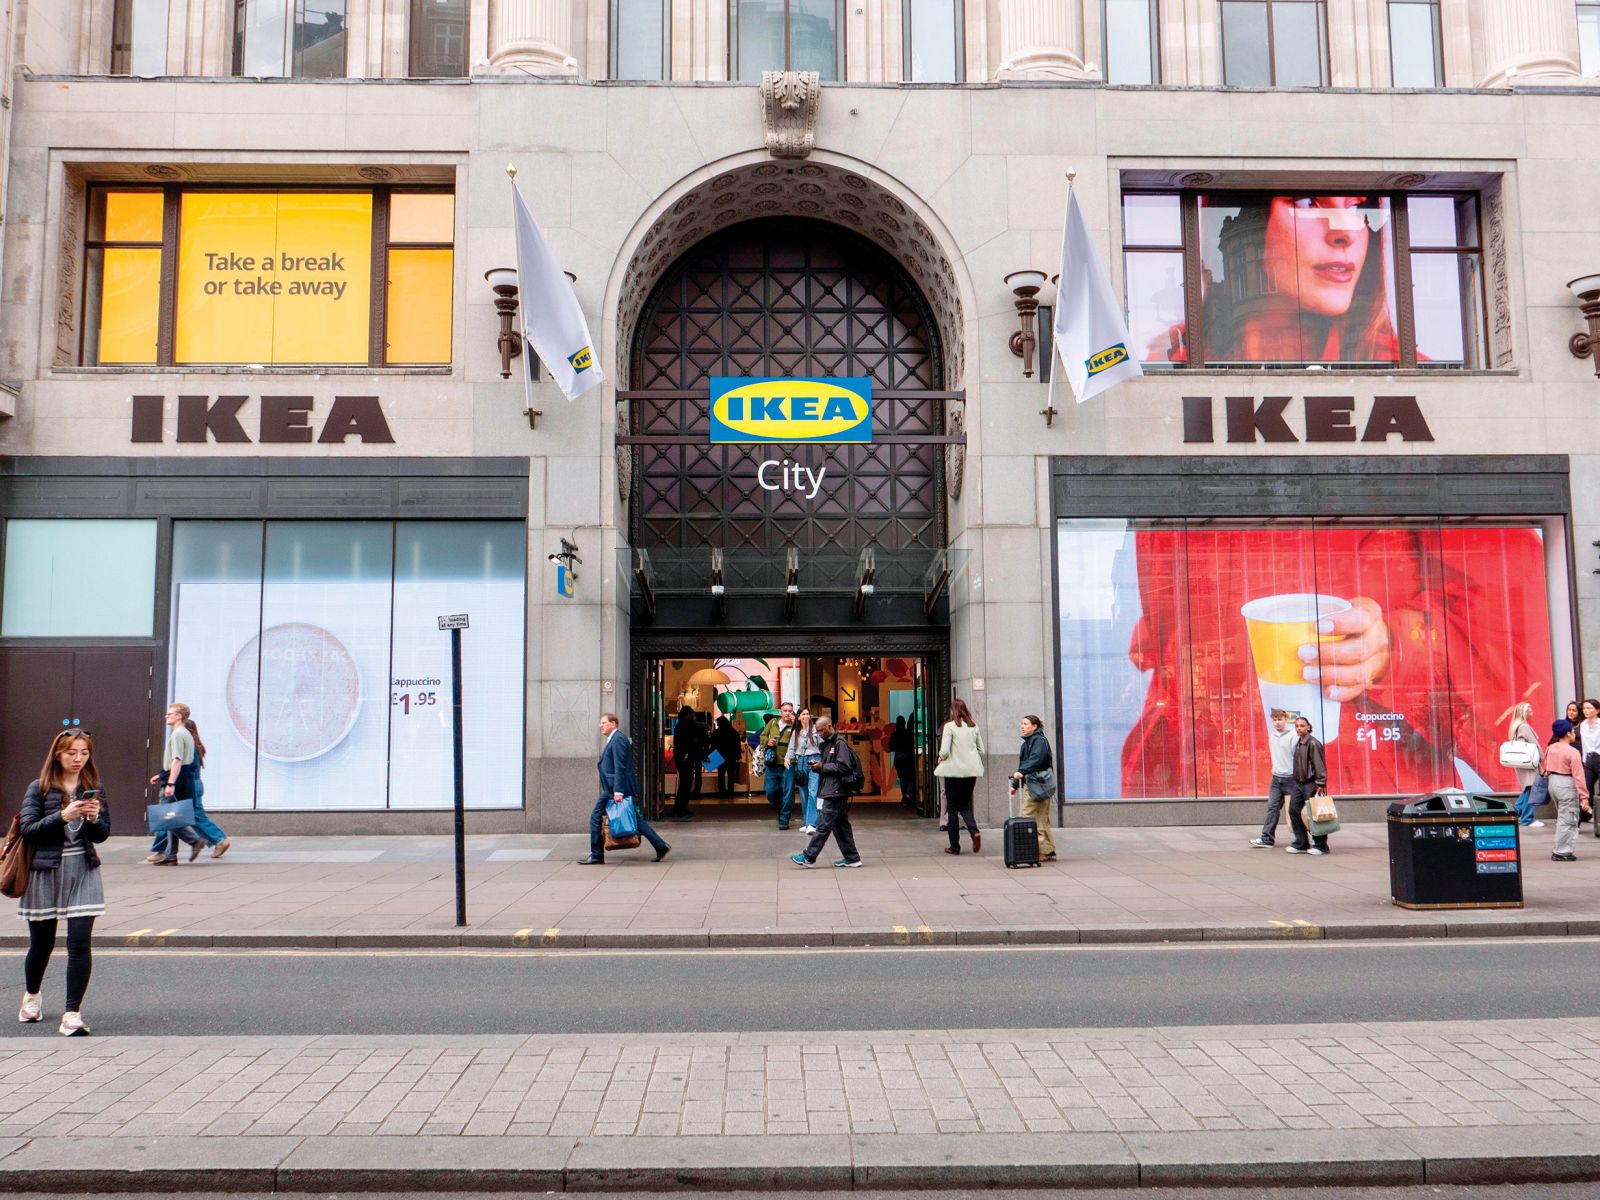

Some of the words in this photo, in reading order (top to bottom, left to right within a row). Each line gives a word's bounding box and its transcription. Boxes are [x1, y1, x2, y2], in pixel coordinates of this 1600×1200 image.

[204, 252, 256, 271] Take
[261, 256, 275, 271] a
[281, 252, 345, 271] break
[203, 280, 228, 295] or
[233, 276, 283, 295] take
[288, 281, 348, 301] away
[1089, 349, 1124, 371] IKEA
[131, 395, 396, 443] IKEA
[728, 397, 858, 421] IKEA
[1181, 396, 1435, 443] IKEA
[757, 459, 826, 499] City
[391, 692, 437, 715] £1.95
[1355, 712, 1405, 723] Cappuccino
[1356, 727, 1401, 750] £1.95
